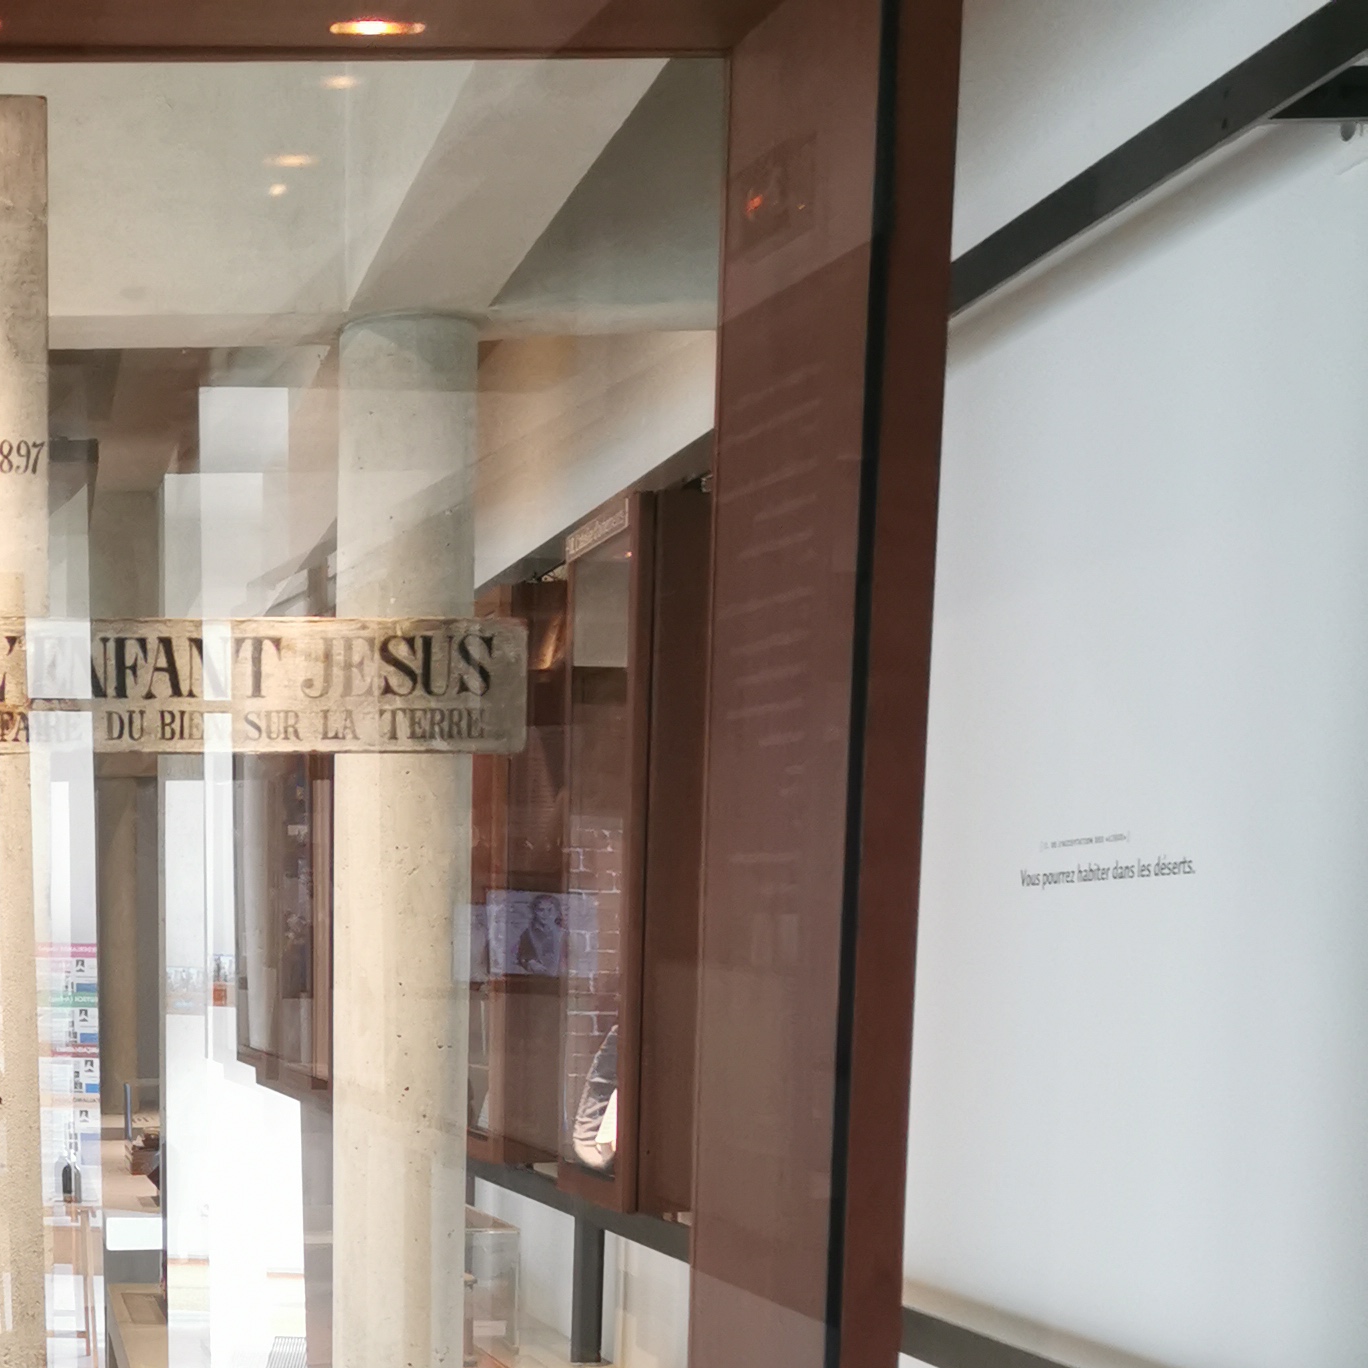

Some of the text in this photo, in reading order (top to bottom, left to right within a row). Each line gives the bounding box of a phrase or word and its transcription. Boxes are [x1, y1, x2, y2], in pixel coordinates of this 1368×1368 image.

[299, 633, 499, 699] JESUS
[105, 710, 147, 741] DU
[243, 710, 303, 741] SUR
[320, 710, 359, 741] LA
[379, 709, 485, 741] TERRE
[1020, 854, 1196, 890] Vous pourrez habiter dans les déserts.
